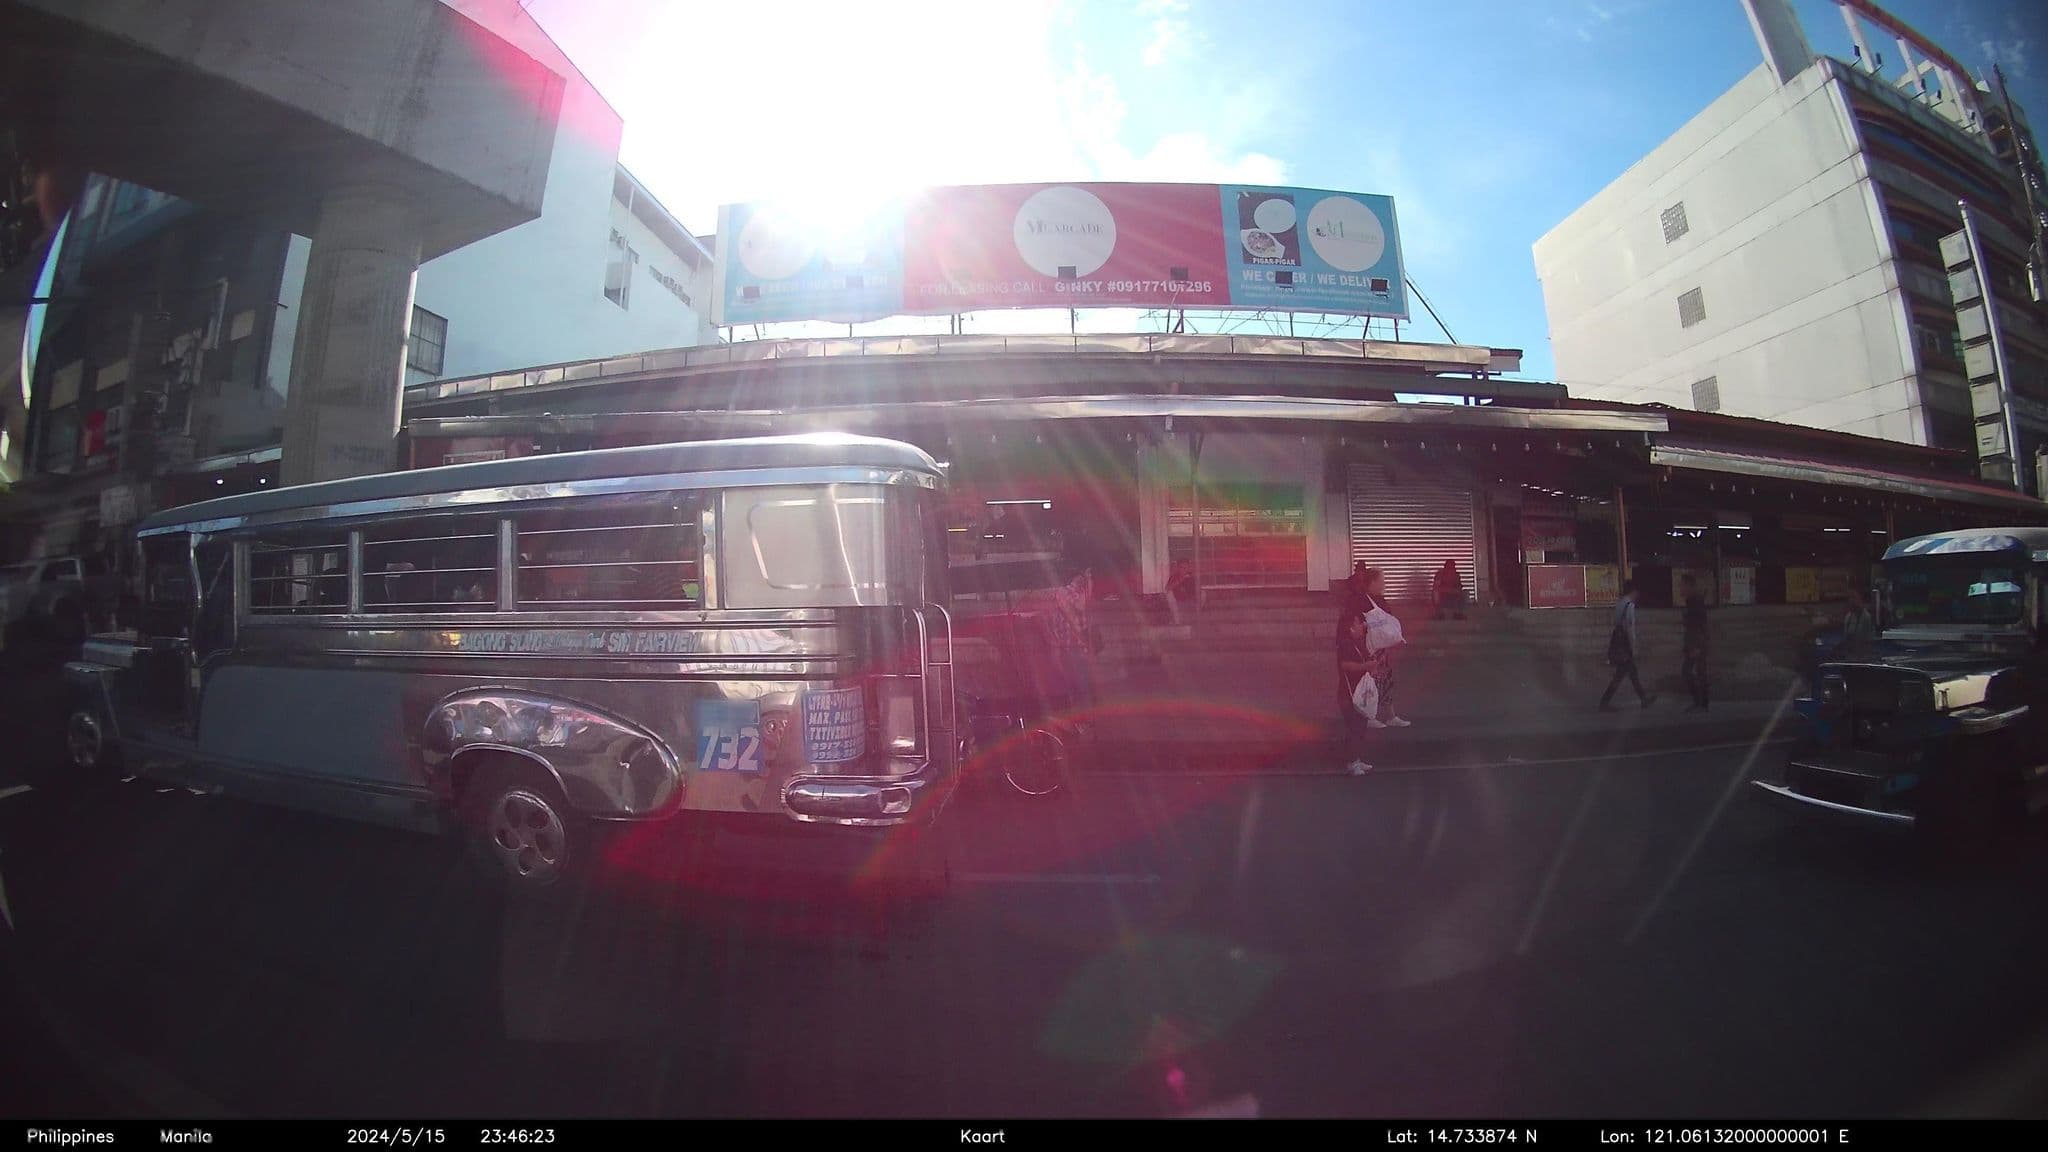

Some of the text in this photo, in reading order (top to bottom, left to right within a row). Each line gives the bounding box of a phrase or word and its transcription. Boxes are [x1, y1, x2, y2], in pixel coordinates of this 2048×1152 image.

[1242, 269, 1263, 281] WE
[1266, 271, 1308, 284] CER
[1317, 273, 1337, 286] WE
[1013, 280, 1046, 294] CALL
[1054, 280, 1103, 293] GINKY
[700, 727, 760, 770] 732
